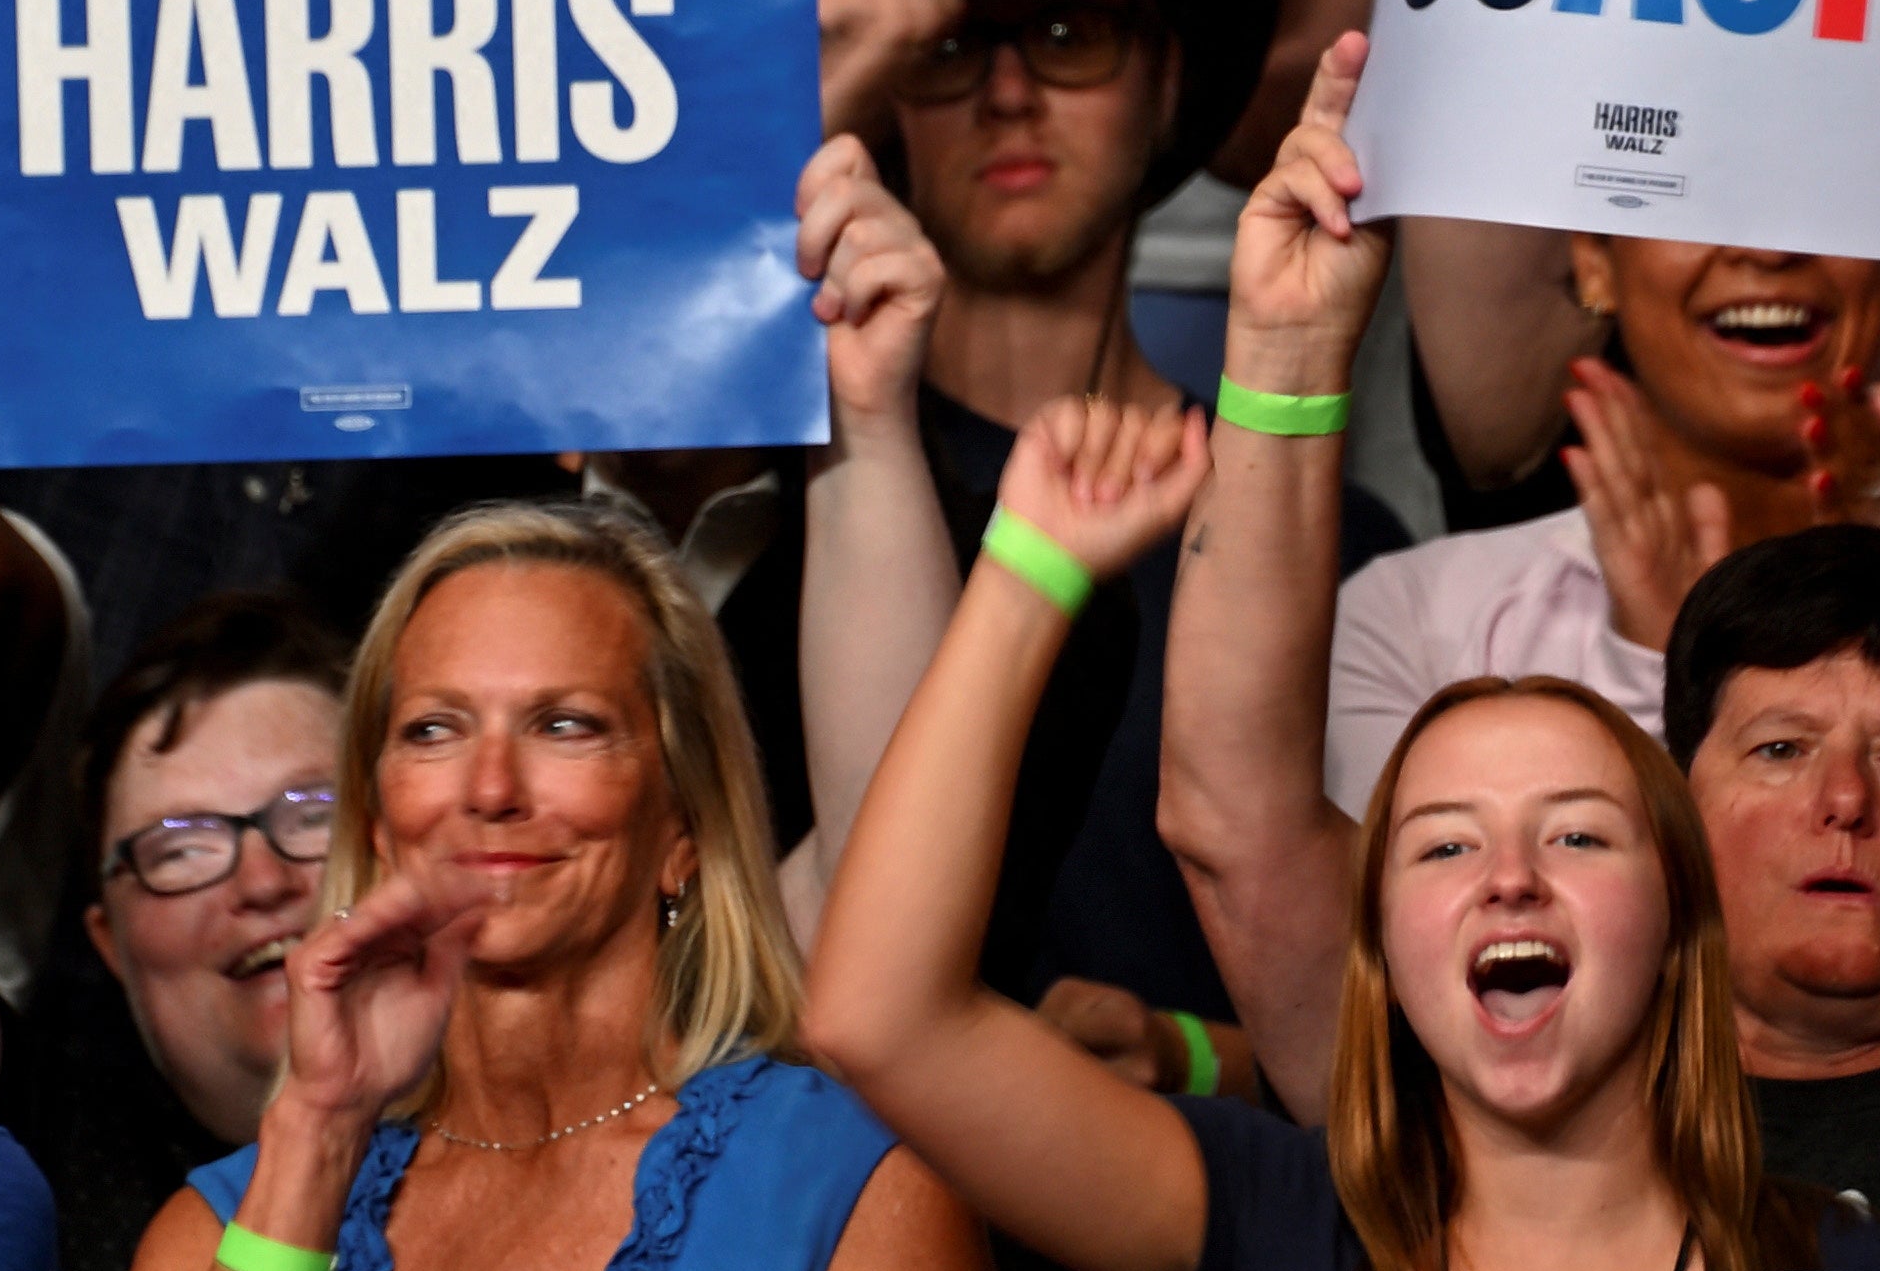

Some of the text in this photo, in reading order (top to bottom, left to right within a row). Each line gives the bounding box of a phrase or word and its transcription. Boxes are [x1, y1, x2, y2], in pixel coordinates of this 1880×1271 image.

[1593, 101, 1681, 138] HARRIS
[1605, 134, 1665, 156] WALZ
[116, 185, 582, 321] WALZ
